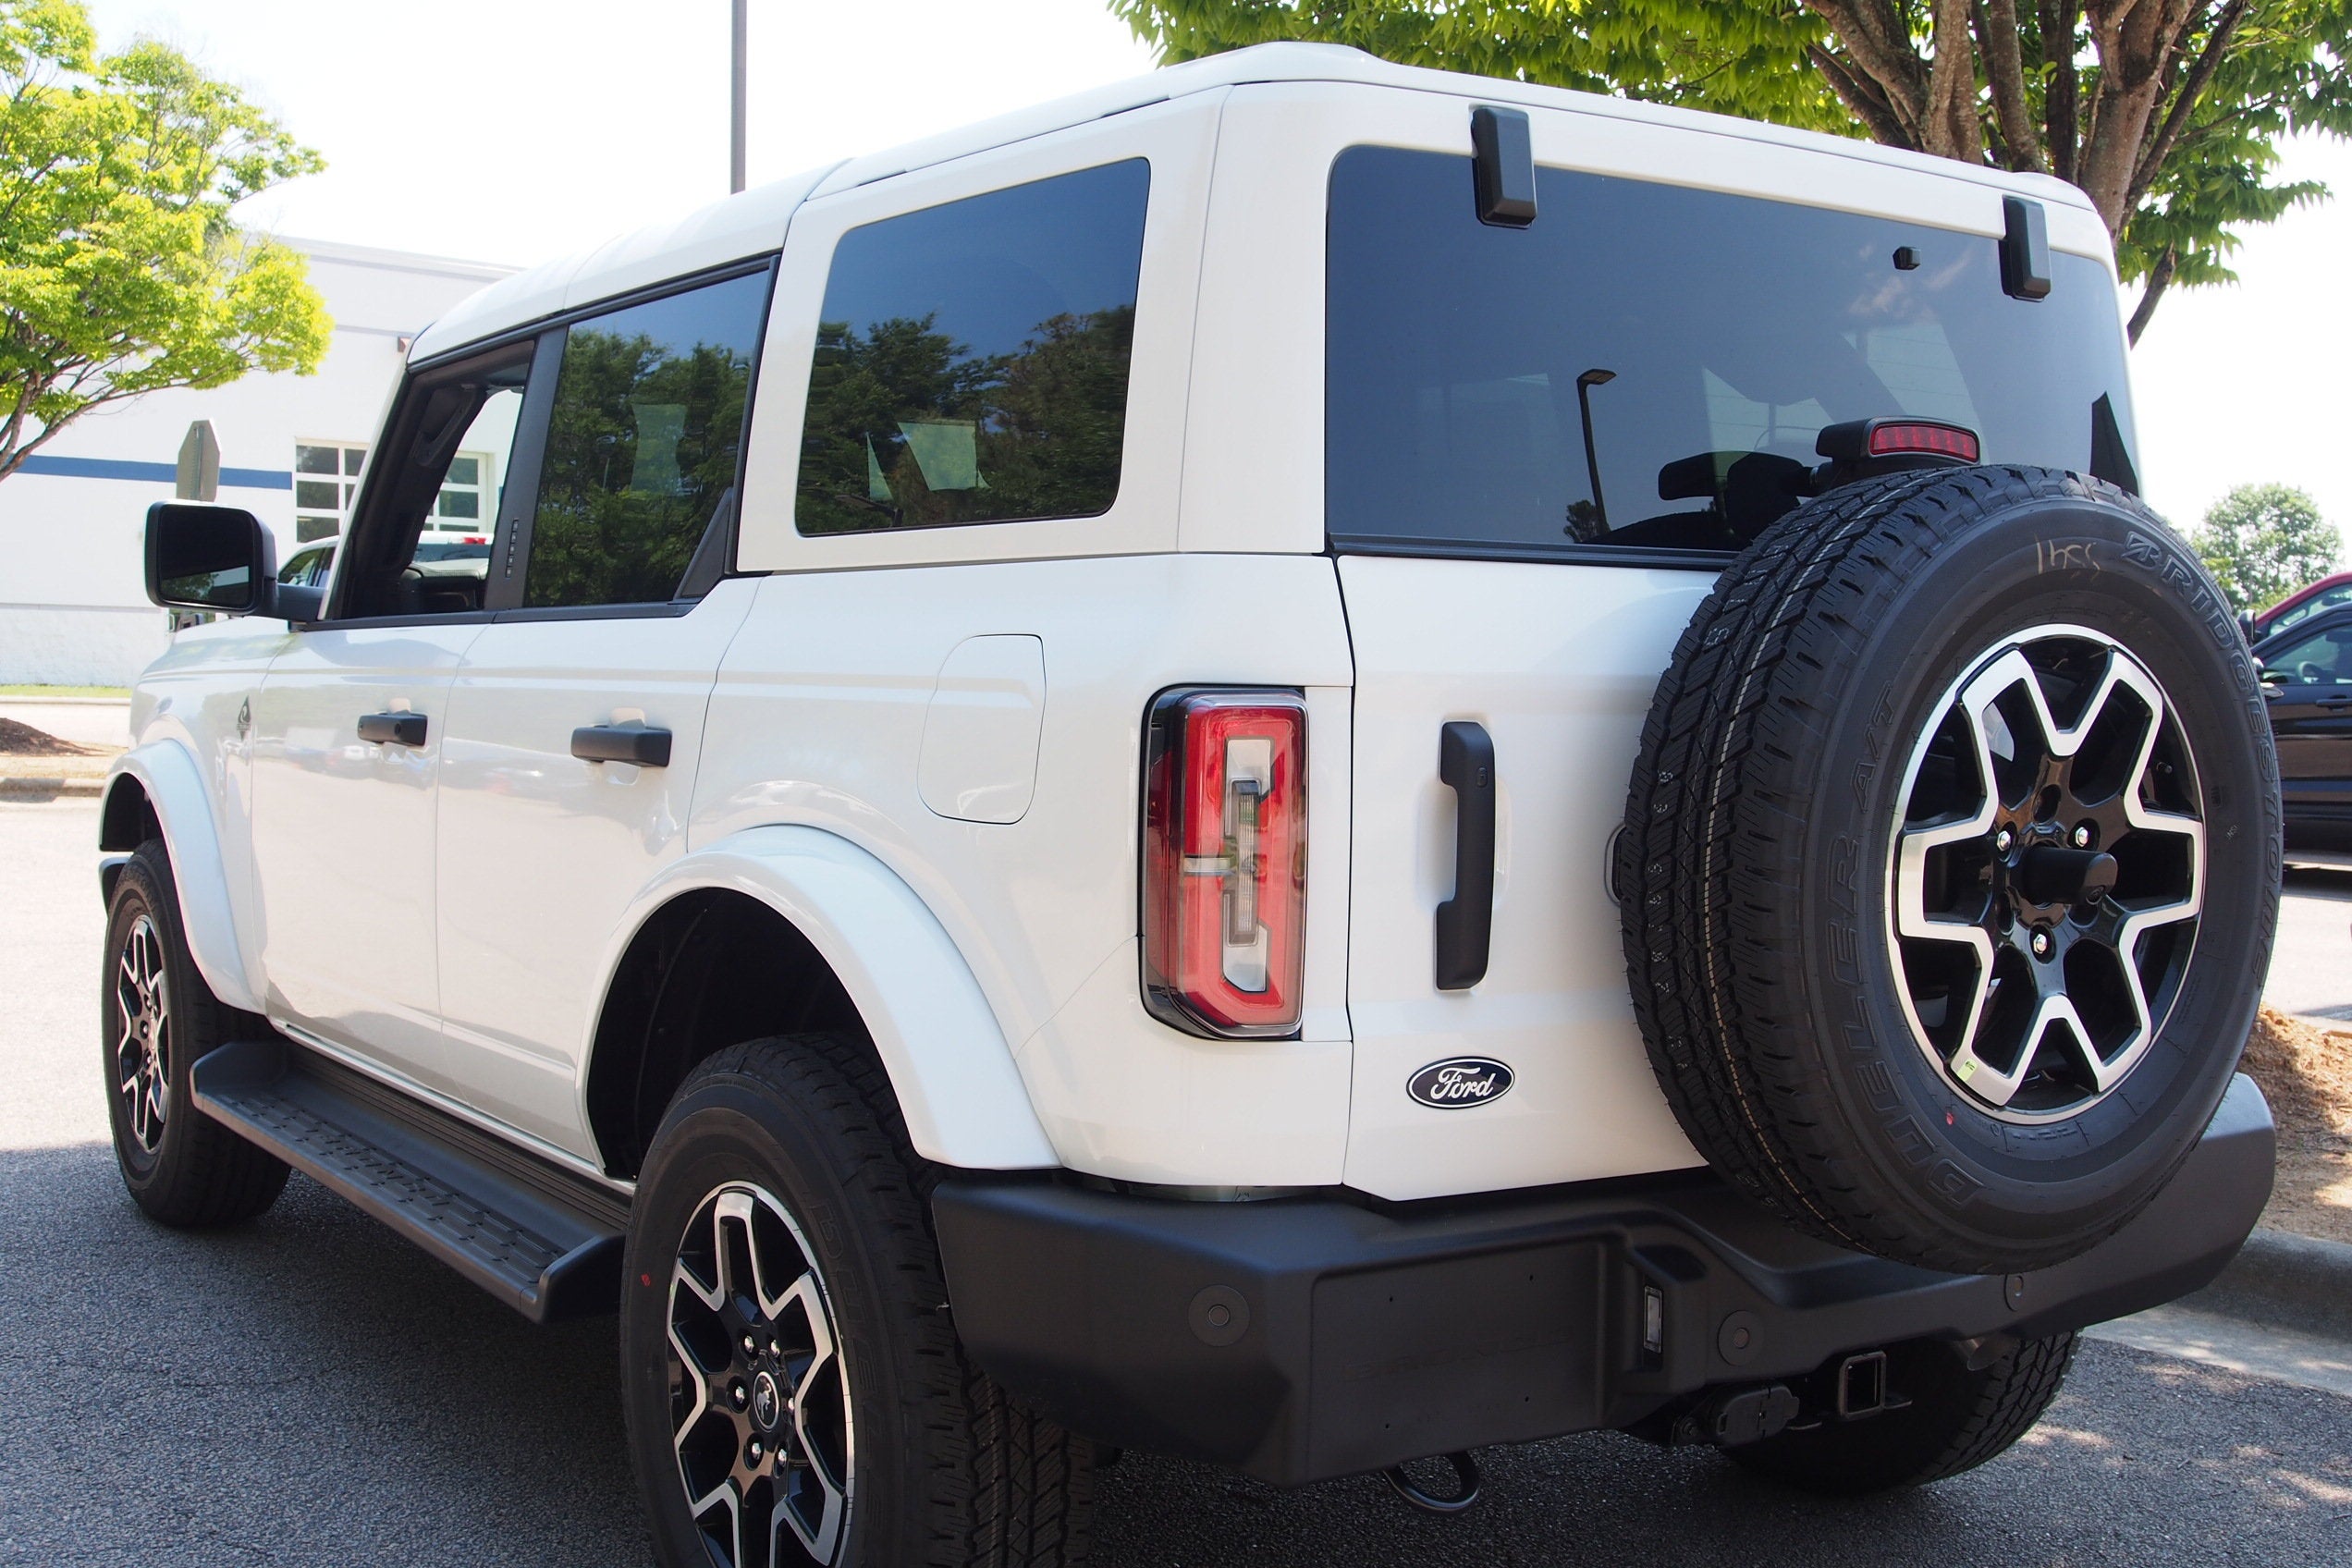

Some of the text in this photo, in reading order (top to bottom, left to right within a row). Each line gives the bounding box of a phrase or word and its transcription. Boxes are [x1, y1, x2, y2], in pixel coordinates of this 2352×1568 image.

[1826, 680, 1986, 1208] DUELER A/T
[2122, 530, 2283, 992] BRIDGESTONE
[1430, 1067, 1496, 1100] Ford
